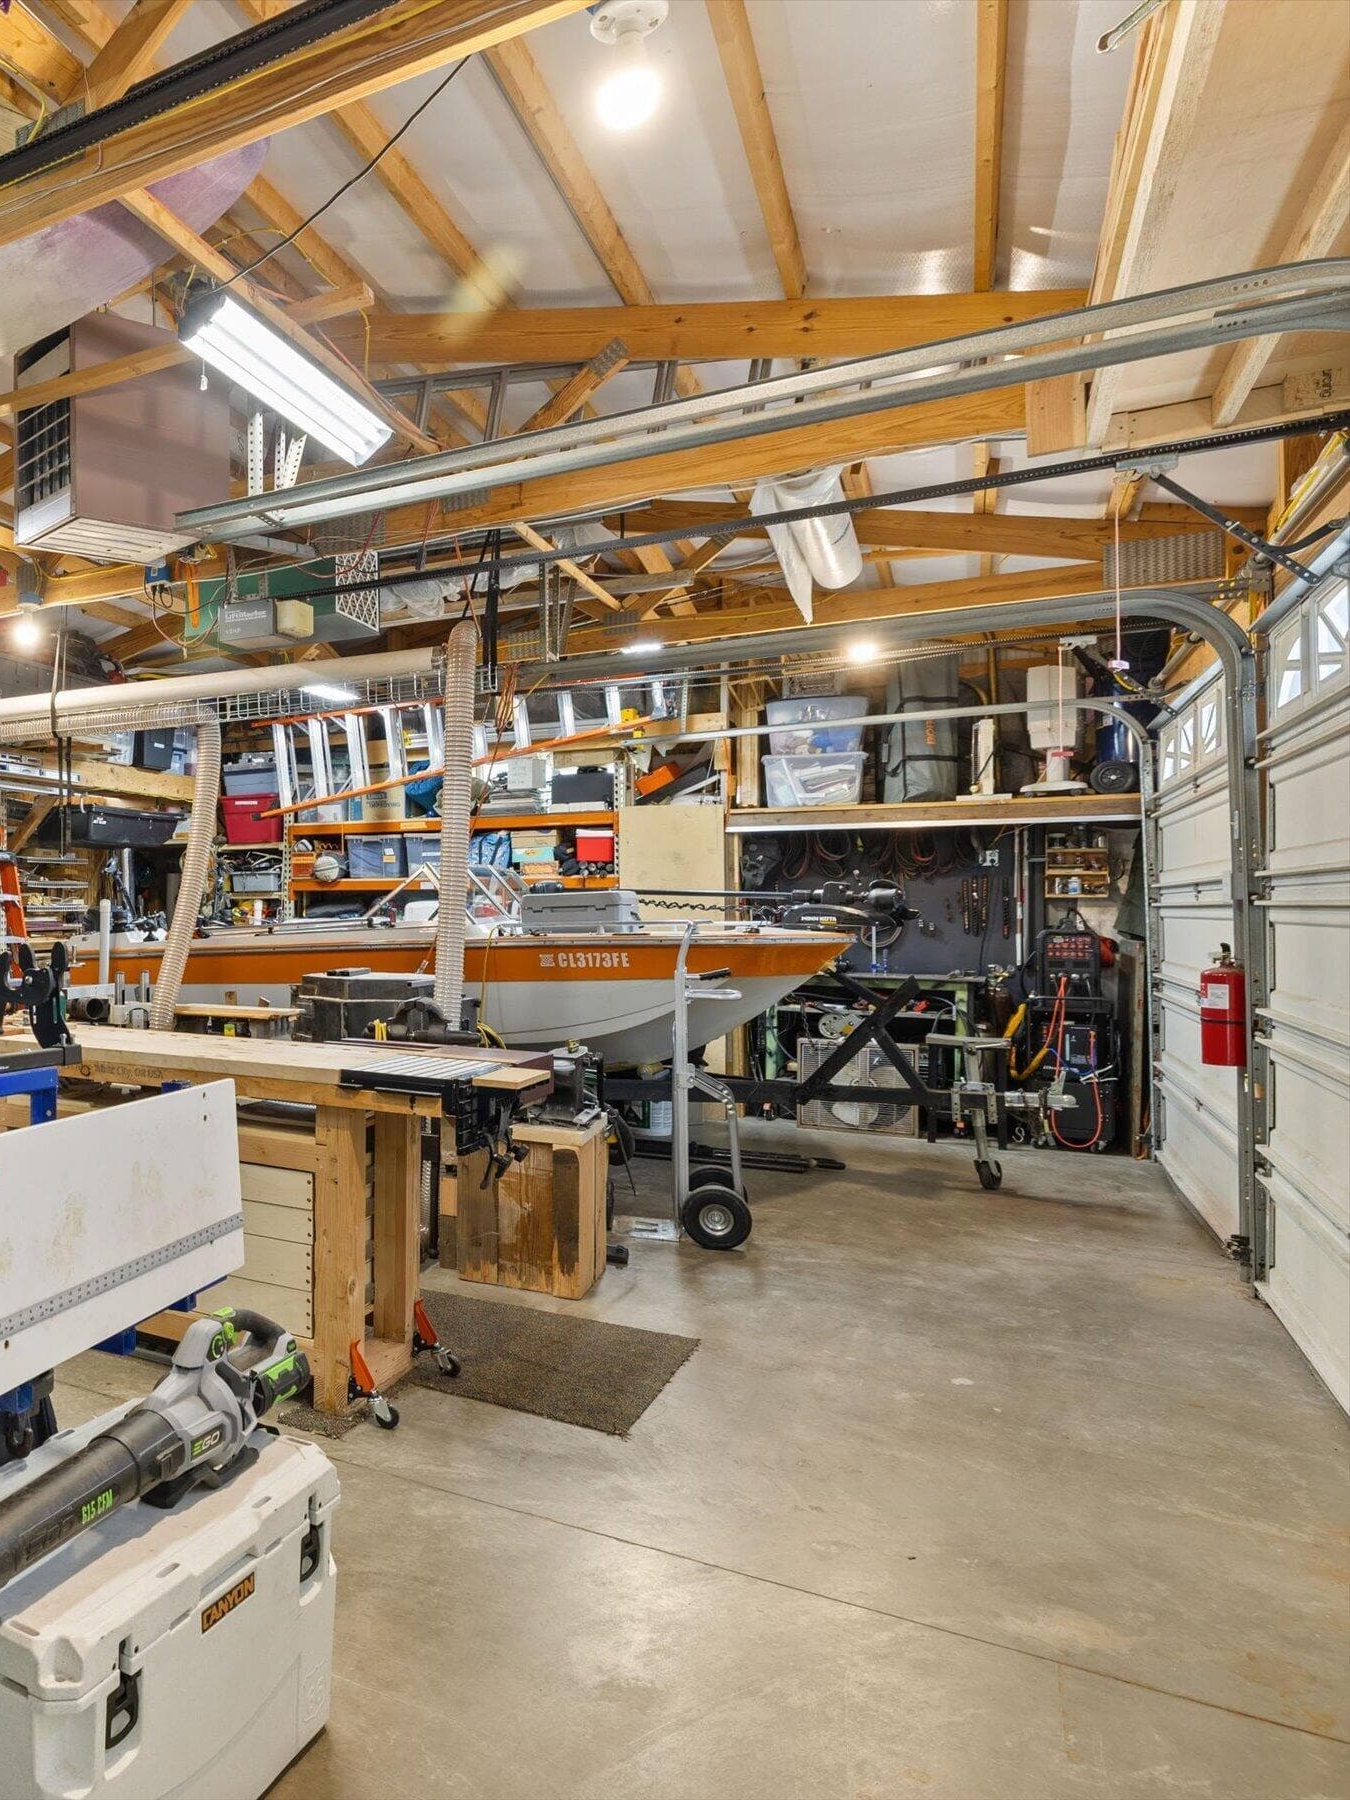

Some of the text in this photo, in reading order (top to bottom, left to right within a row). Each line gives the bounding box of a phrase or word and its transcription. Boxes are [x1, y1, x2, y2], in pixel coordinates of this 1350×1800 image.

[557, 952, 630, 968] CL3173FE
[193, 1430, 221, 1455] EGO
[82, 1489, 113, 1525] 615 CFM
[203, 1573, 255, 1632] CANYON
